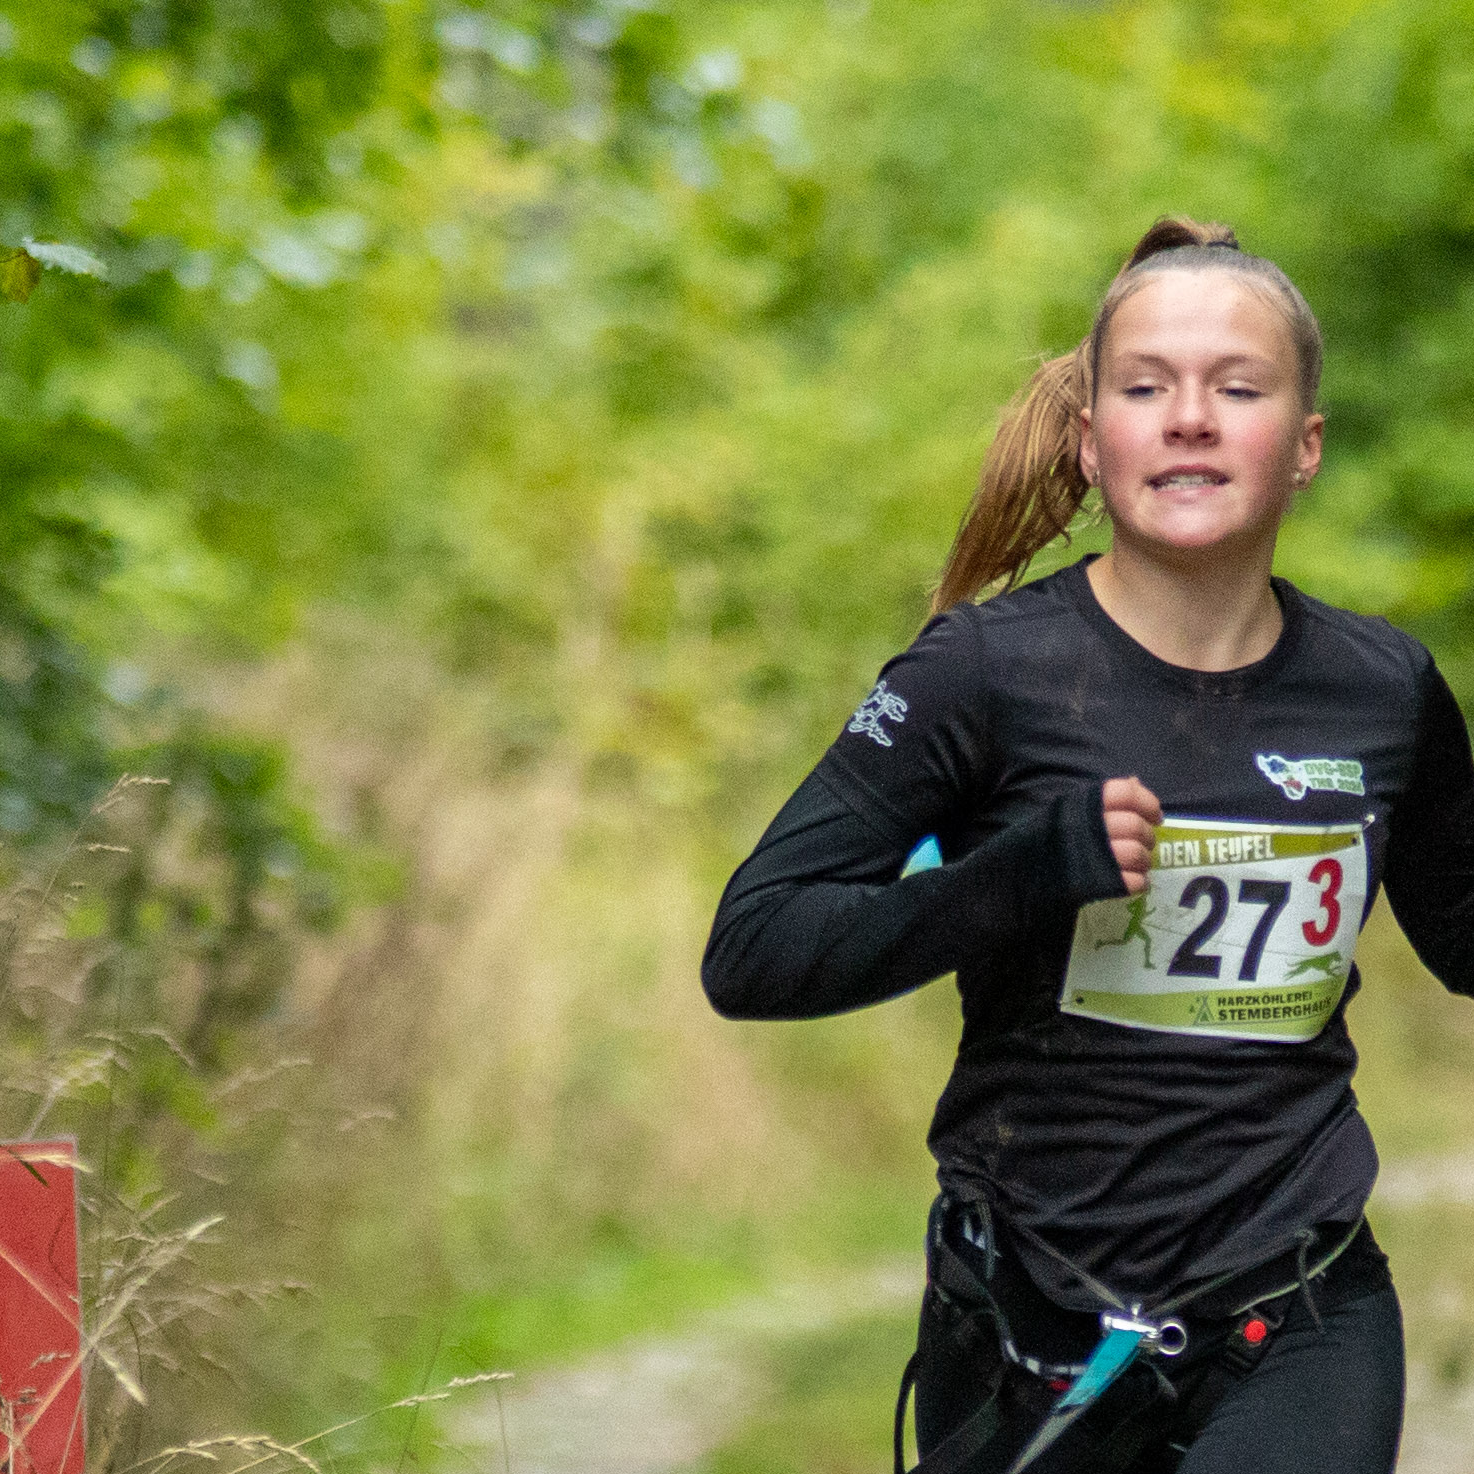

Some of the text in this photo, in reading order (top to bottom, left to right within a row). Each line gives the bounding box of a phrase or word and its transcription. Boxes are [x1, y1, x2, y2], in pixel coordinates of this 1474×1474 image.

[1159, 834, 1275, 868] DEN TEUFEL
[1217, 990, 1313, 1007] HARZKÖHLEREI
